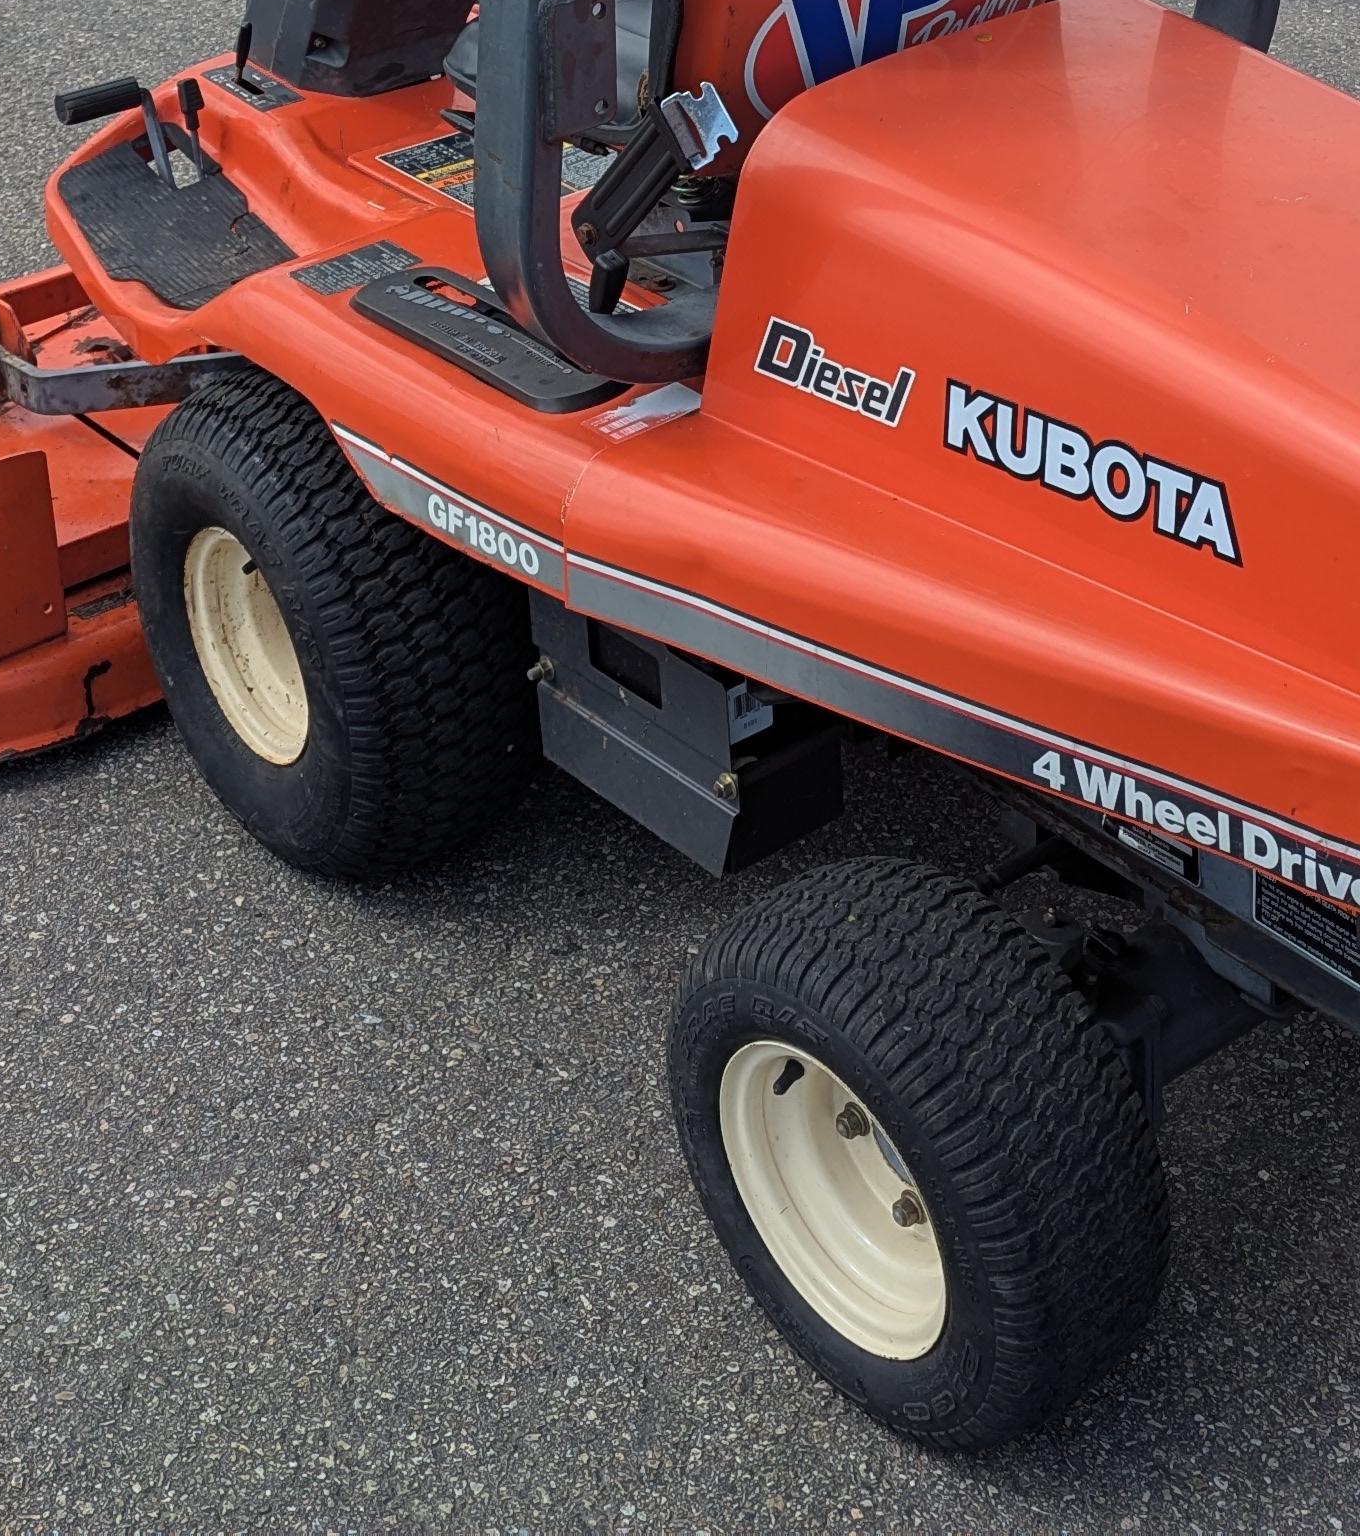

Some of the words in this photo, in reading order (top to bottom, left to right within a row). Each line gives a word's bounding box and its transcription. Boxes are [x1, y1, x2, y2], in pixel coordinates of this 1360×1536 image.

[755, 316, 915, 428] Diesel
[943, 378, 1244, 568] KUBOTA
[427, 494, 540, 576] GF1800
[1033, 750, 1065, 791] 4
[1073, 759, 1231, 854] Wheel
